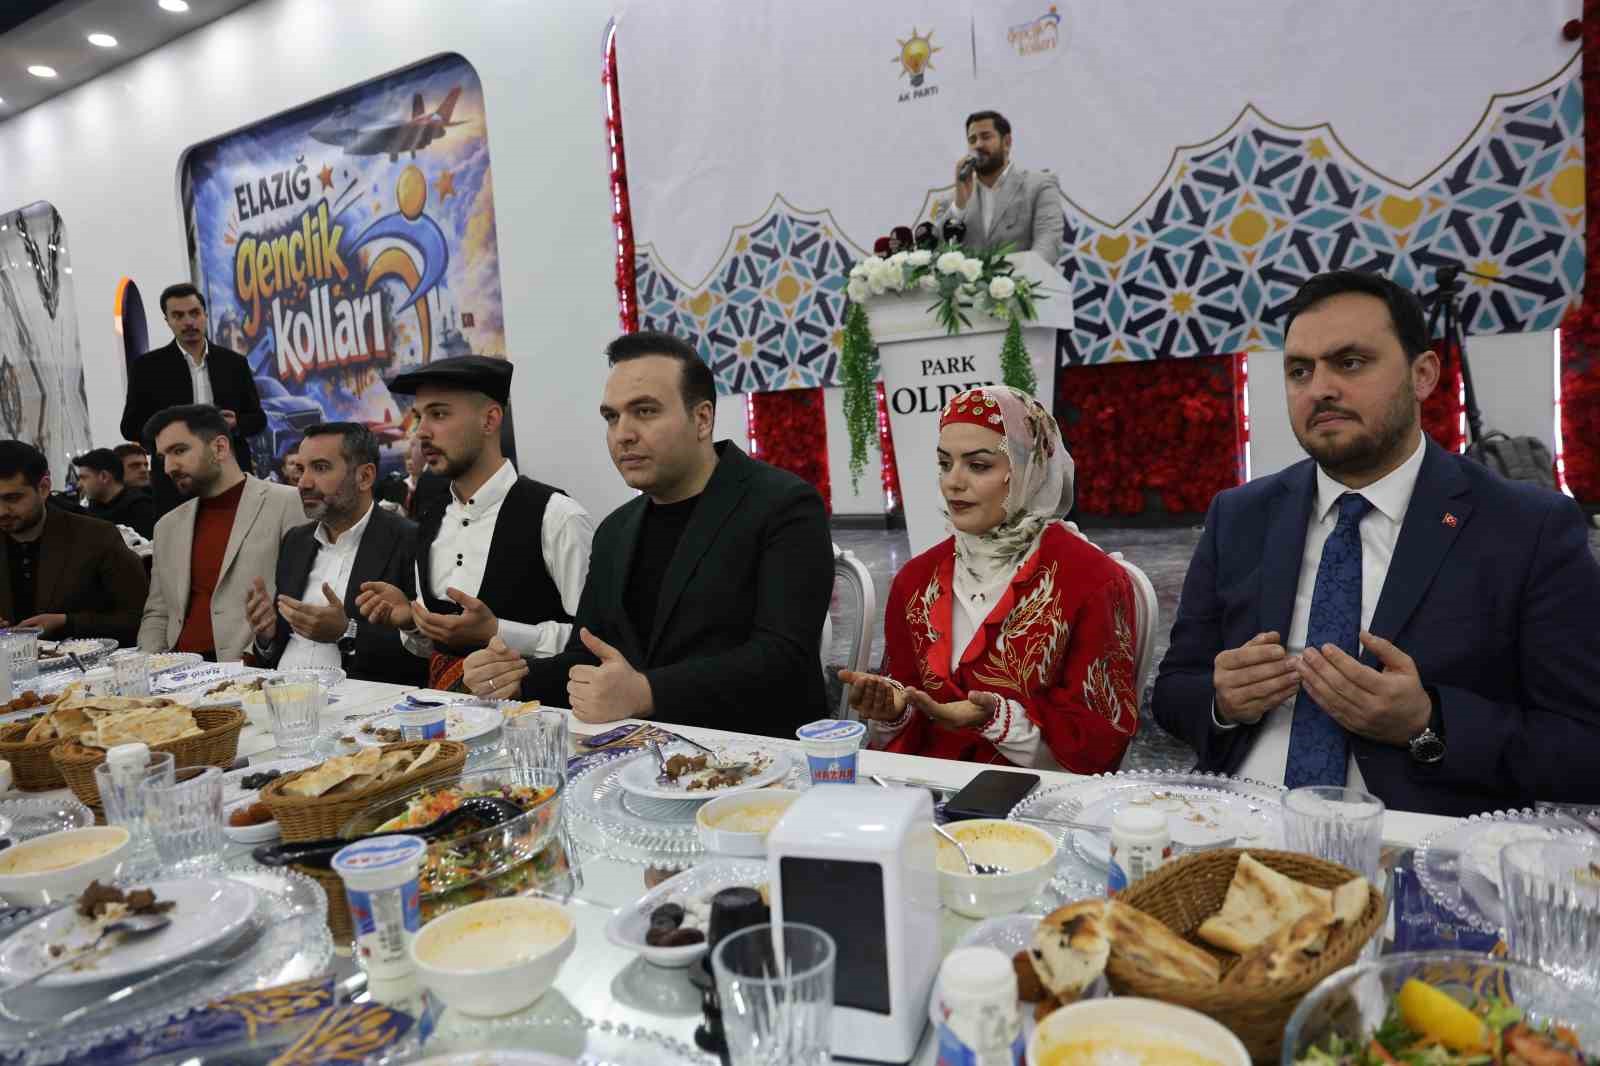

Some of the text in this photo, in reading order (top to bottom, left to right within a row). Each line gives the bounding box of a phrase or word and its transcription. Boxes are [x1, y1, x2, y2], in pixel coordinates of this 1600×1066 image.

[897, 92, 910, 103] AK
[234, 154, 311, 221] ELAZIĞ
[235, 202, 348, 336] gençlik
[271, 286, 385, 381] kolları
[921, 355, 976, 376] PARK
[892, 381, 995, 415] OLD
